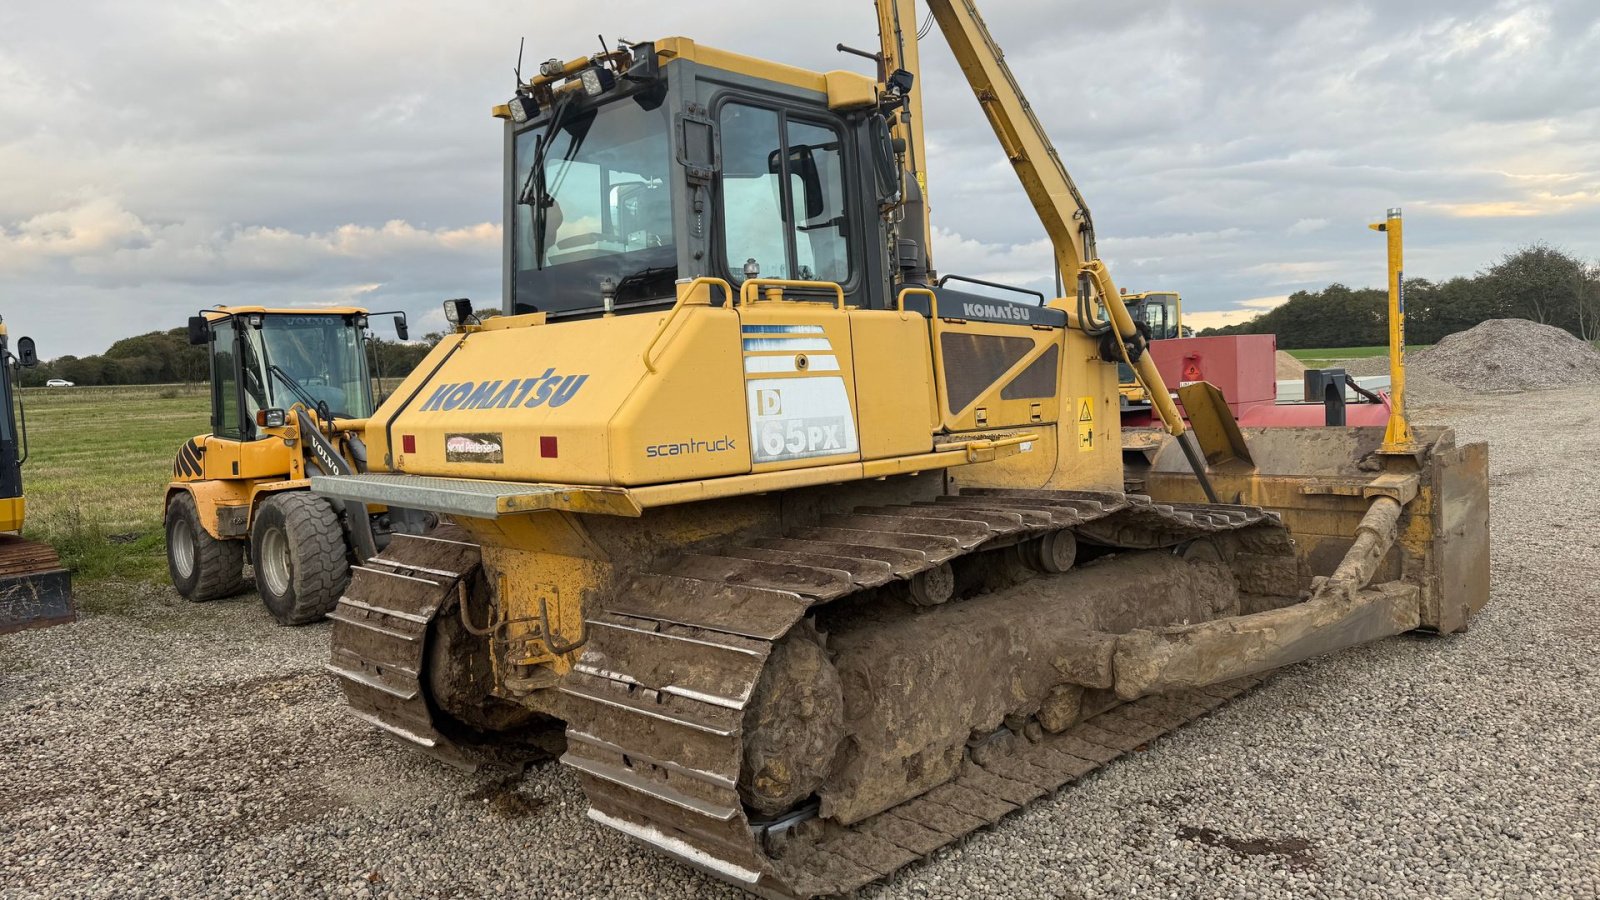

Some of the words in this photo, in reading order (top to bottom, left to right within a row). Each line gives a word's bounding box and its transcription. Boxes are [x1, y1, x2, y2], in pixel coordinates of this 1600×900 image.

[963, 303, 1030, 320] KOMATSU
[419, 367, 590, 411] KOMATSU
[762, 389, 781, 416] D
[646, 435, 736, 458] scantruck
[761, 419, 840, 456] 65PX
[311, 435, 340, 476] VOLVO
